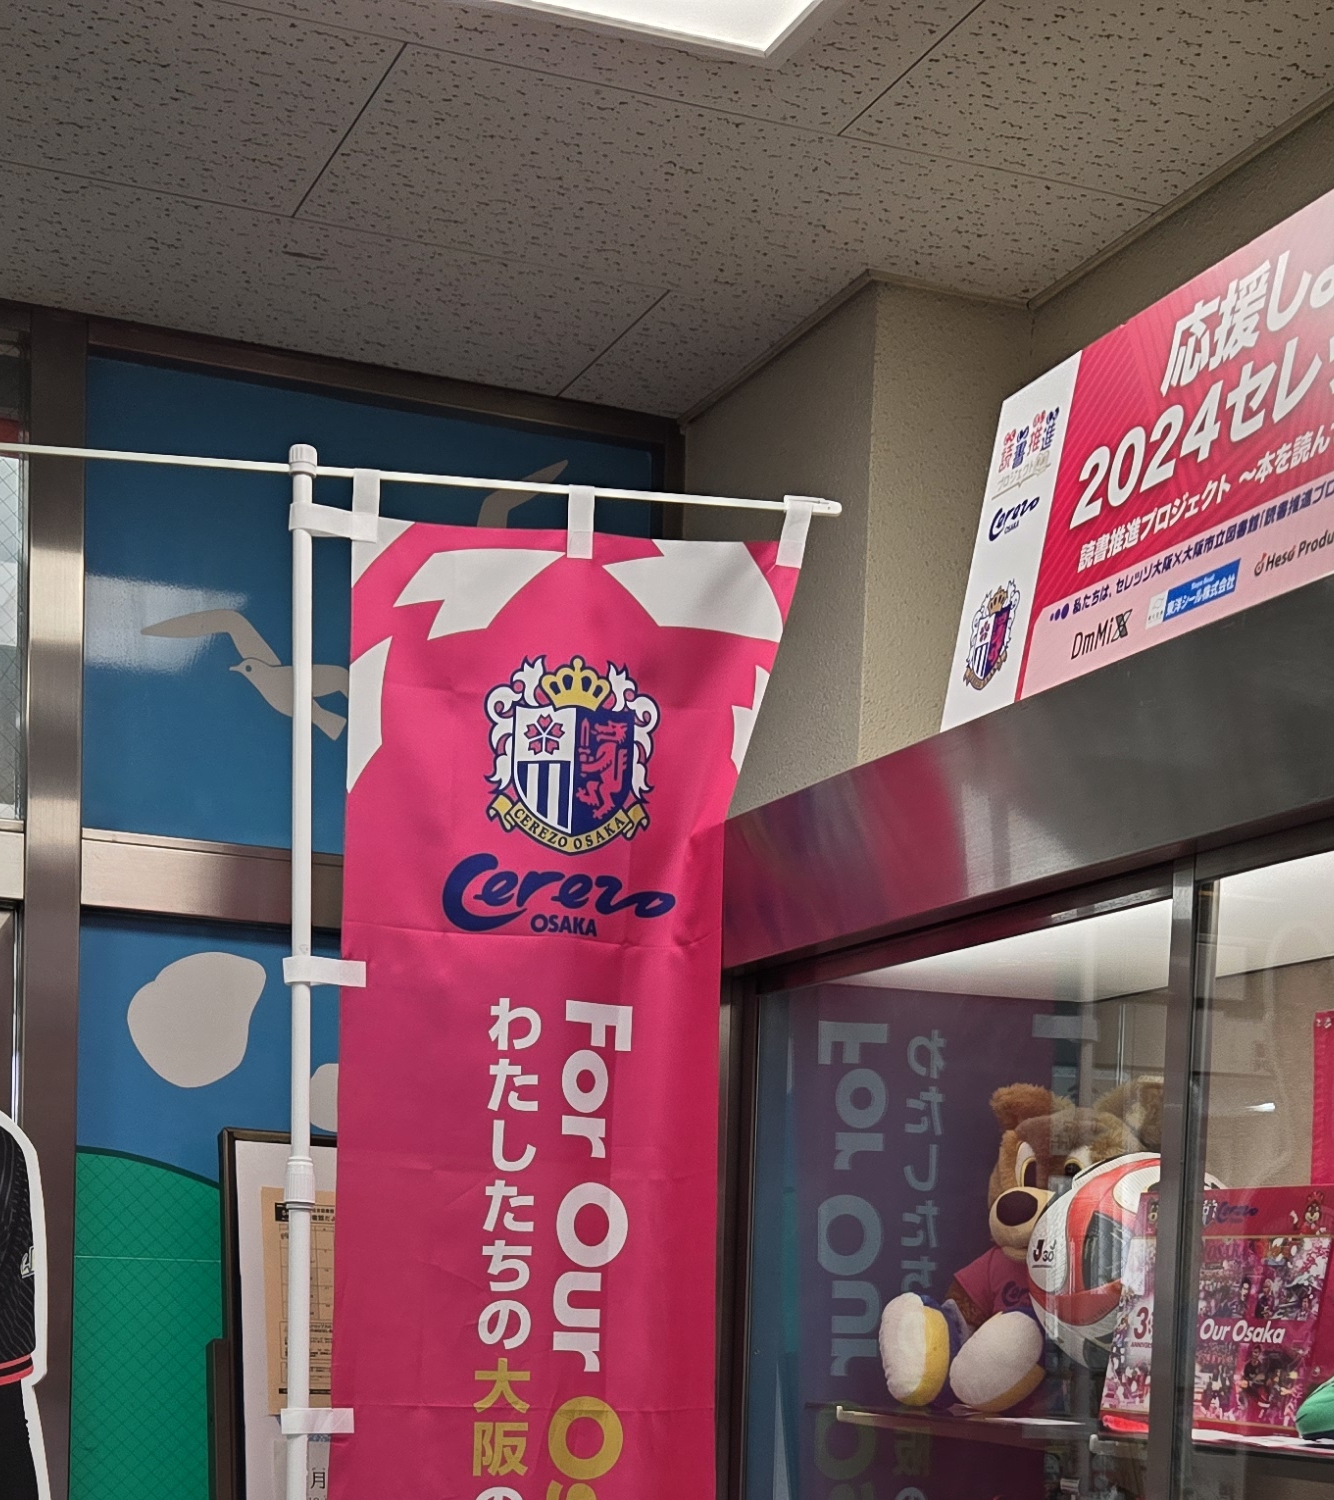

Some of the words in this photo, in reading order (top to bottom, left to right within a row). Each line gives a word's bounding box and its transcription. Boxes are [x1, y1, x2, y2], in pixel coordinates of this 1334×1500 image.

[1077, 474, 1231, 573] 読書推進プロジェクト
[514, 807, 568, 849] CEREZO
[573, 815, 625, 851] OSAKA
[442, 852, 676, 932] Cerezo
[530, 913, 597, 937] OSAKA
[561, 1000, 633, 1159] For
[552, 1182, 628, 1373] Our
[1199, 1319, 1231, 1340] Our
[1232, 1320, 1285, 1344] Osaka
